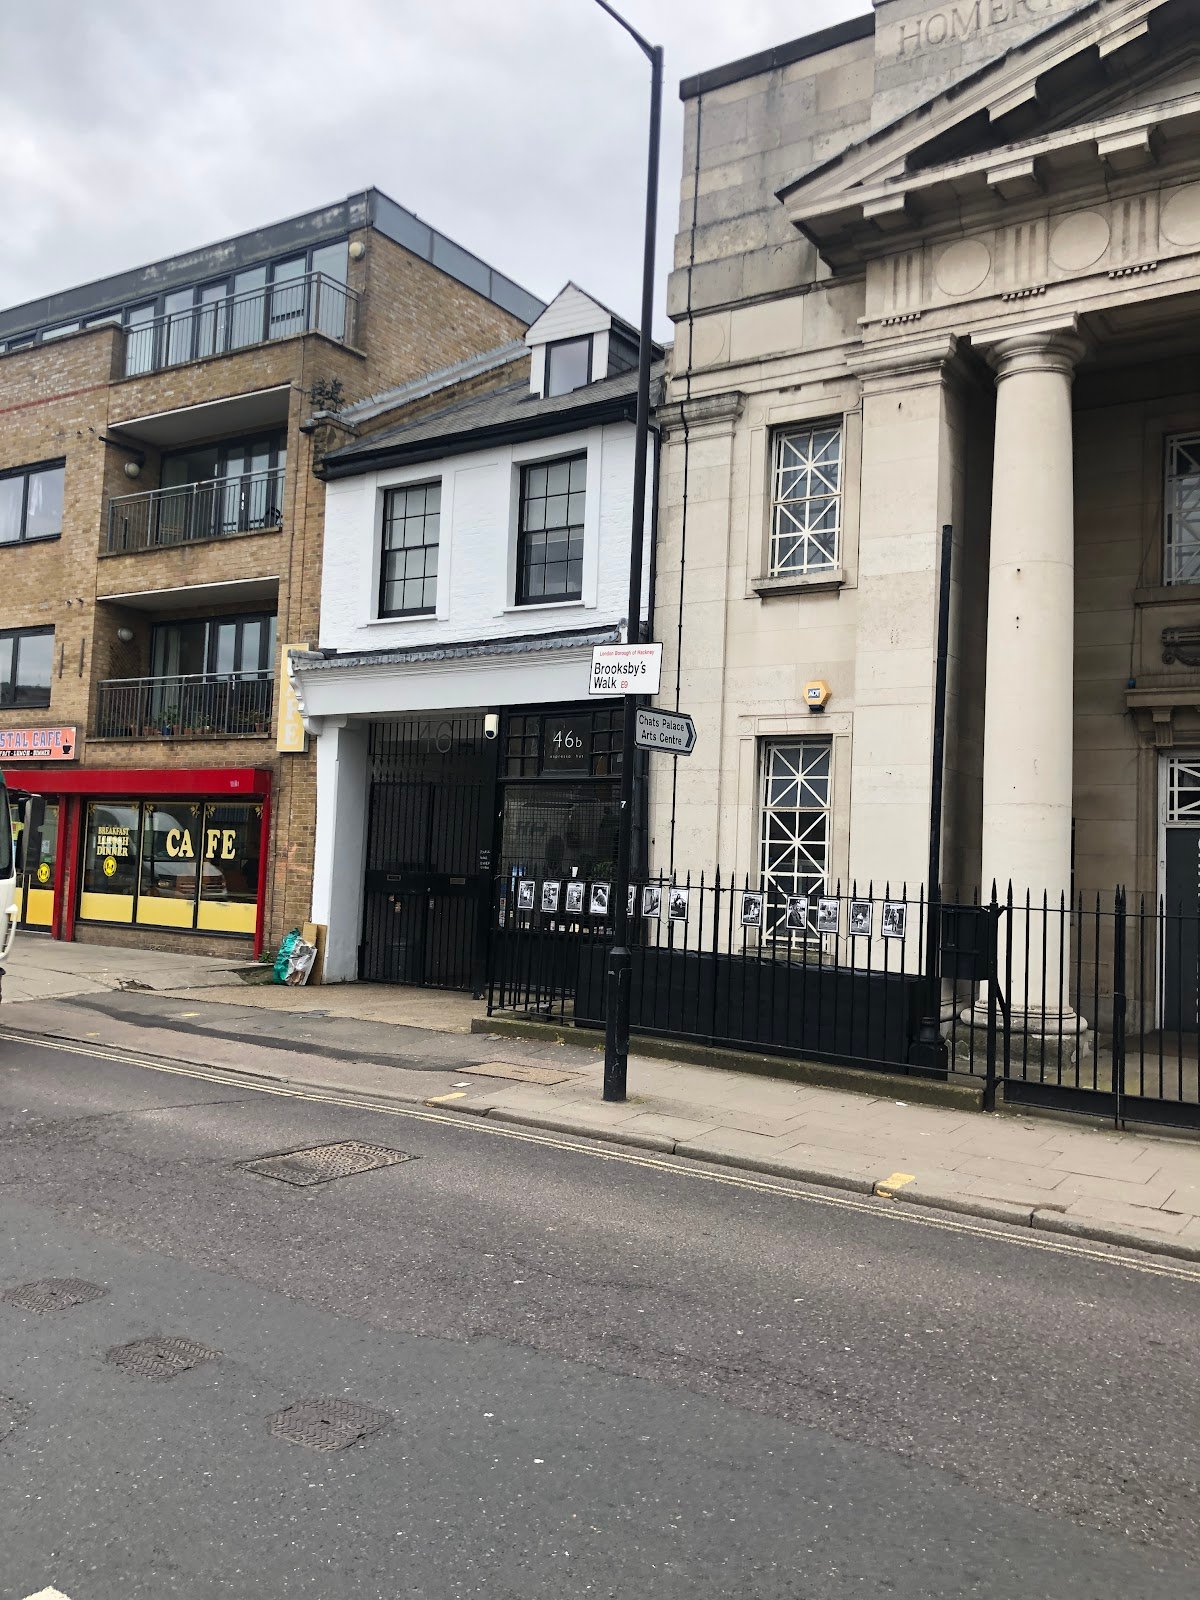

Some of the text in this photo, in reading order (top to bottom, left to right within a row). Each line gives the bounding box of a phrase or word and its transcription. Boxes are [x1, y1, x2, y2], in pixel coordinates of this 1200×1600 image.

[896, 0, 1054, 58] HOMER
[594, 661, 646, 676] Brooksby's
[594, 677, 629, 689] Walk E9
[638, 714, 685, 732] Chats Palace
[32, 731, 61, 747] CAFE
[553, 730, 583, 748] 46b
[641, 730, 682, 745] Arts Centre
[620, 800, 627, 808] 7
[97, 826, 129, 836] BREAKFAST
[97, 836, 129, 846] LUNCH
[96, 846, 129, 857] DINNER
